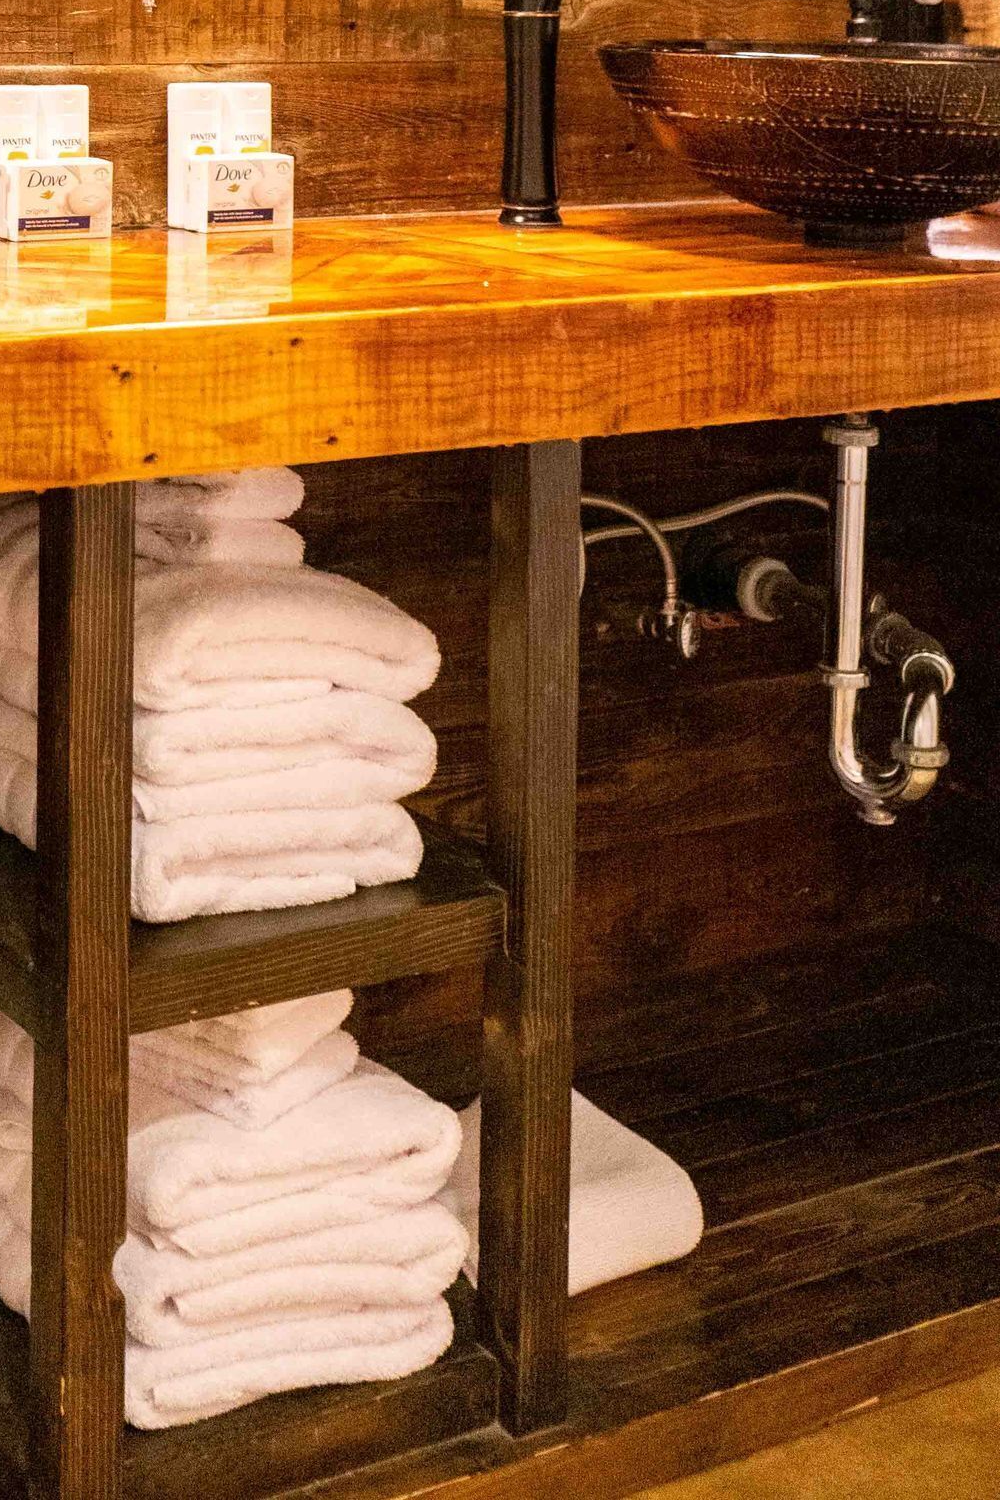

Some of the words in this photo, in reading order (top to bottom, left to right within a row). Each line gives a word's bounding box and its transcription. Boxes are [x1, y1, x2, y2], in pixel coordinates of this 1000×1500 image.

[2, 137, 31, 145] PANTENE
[52, 138, 82, 146] PANTENE
[27, 169, 67, 188] Dove
[215, 164, 252, 181] Dove
